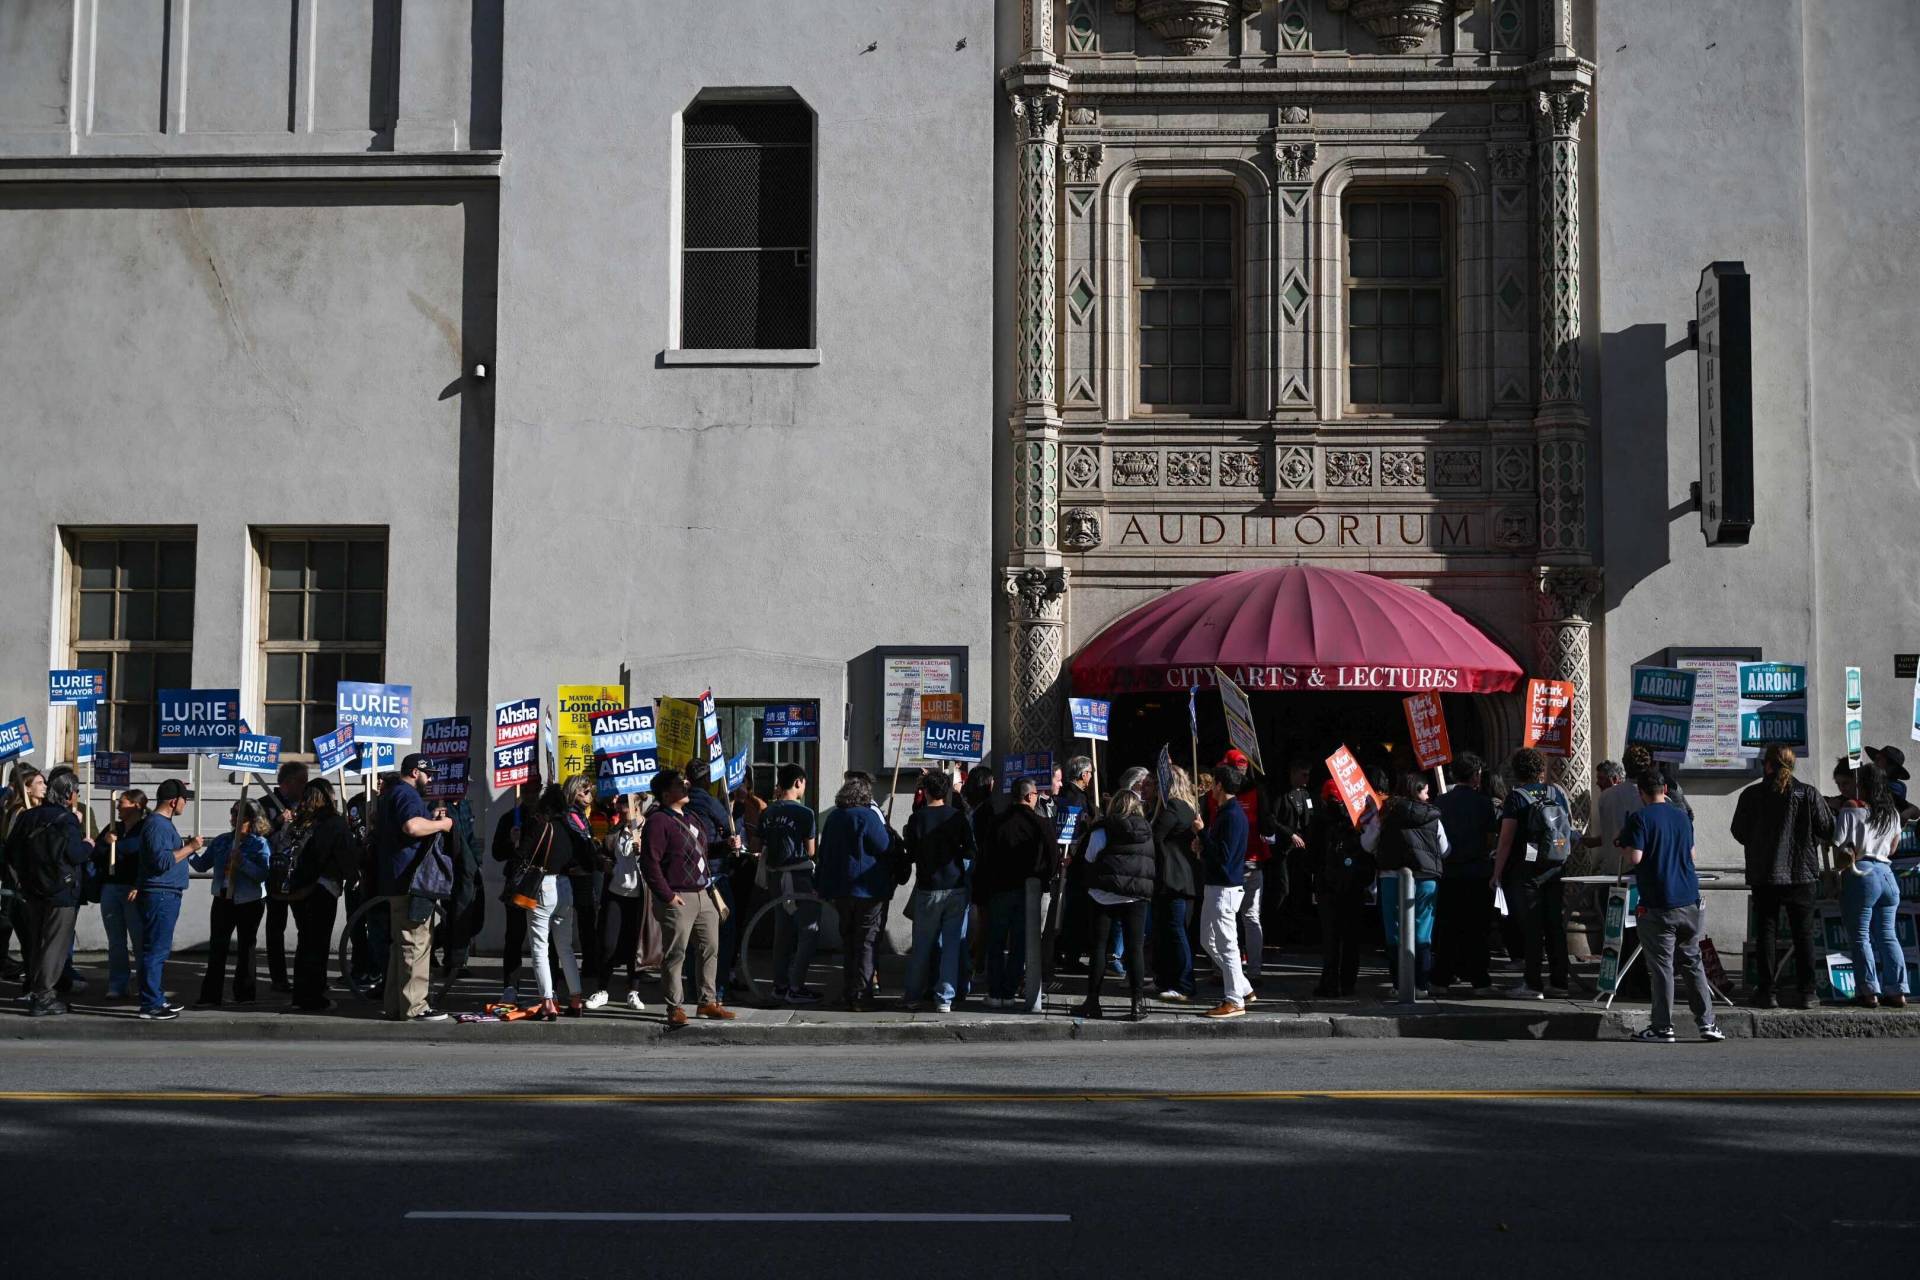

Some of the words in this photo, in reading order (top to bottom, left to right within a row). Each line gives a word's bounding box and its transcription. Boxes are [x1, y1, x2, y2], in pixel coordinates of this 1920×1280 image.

[1120, 514, 1472, 546] AUDITORIUM
[51, 676, 93, 688] LURIE
[1166, 667, 1219, 688] CITY
[1234, 667, 1297, 688] ARTS
[1307, 667, 1326, 687] &
[1337, 666, 1458, 688] LECTURES
[1748, 672, 1797, 691] AARON!
[1534, 682, 1563, 697] Mark
[1641, 676, 1686, 698] AARON!
[339, 693, 400, 714] LURIE
[560, 700, 622, 712] London
[923, 700, 953, 712] LURIE
[1532, 696, 1568, 708] Farrell
[161, 702, 227, 721] LURIE
[498, 702, 538, 725] Ahsha
[161, 724, 180, 732] FOR
[184, 724, 236, 736] MAYOR
[340, 714, 358, 722] FOR
[361, 715, 408, 729] MAYOR
[425, 720, 468, 740] Ahsha
[594, 710, 652, 734] Ahsha
[1532, 716, 1568, 728] Mayor
[1748, 720, 1797, 738] AARON!
[0, 726, 20, 744] RIE
[502, 722, 537, 741] MAYOR
[600, 732, 654, 748] MAYOR
[926, 727, 970, 742] LURIE
[1635, 721, 1681, 744] AARON!
[238, 740, 268, 754] URIE
[427, 741, 468, 755] MAYOR
[940, 742, 970, 752] MAYOR
[235, 754, 266, 763] MAYOR
[599, 753, 656, 776] Ahsha
